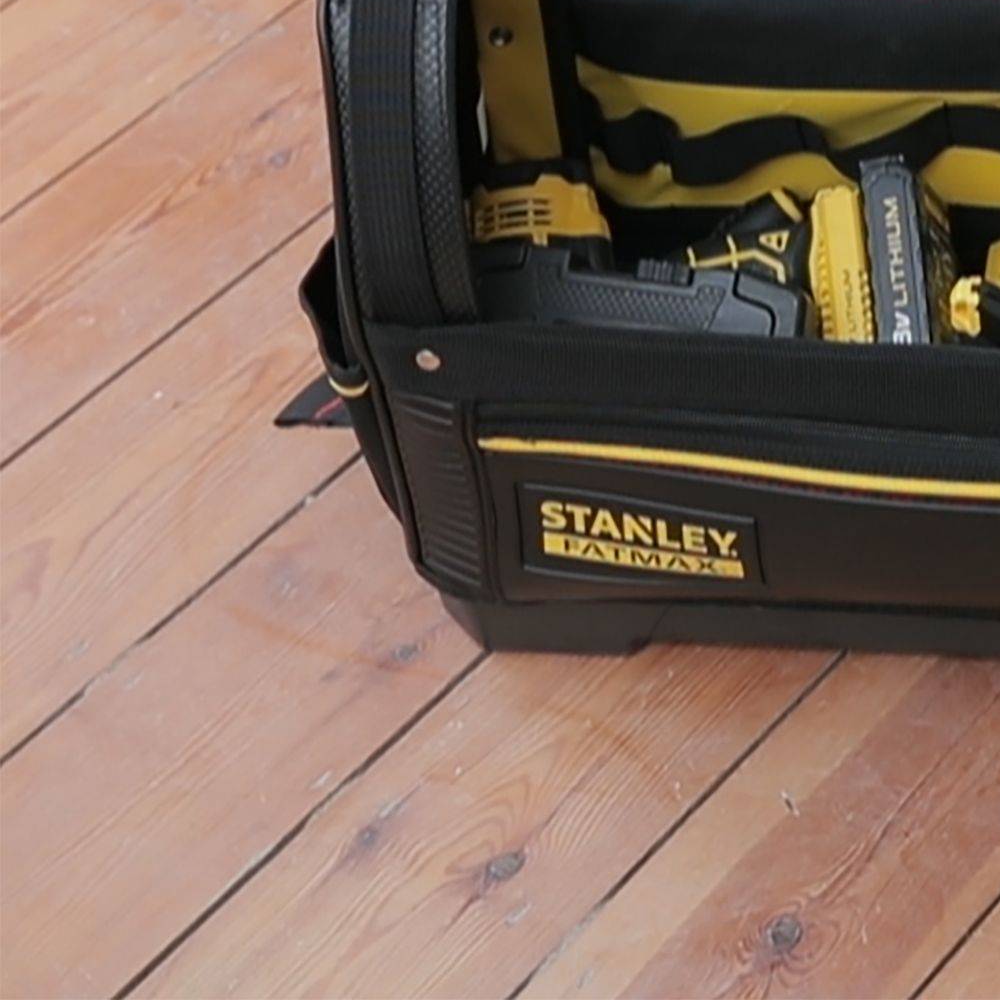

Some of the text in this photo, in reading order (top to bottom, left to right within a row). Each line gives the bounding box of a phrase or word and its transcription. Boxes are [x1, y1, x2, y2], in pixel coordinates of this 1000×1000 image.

[883, 196, 909, 308] LITHIUM
[540, 500, 738, 557] STANLEY
[561, 536, 722, 576] FATMAX
